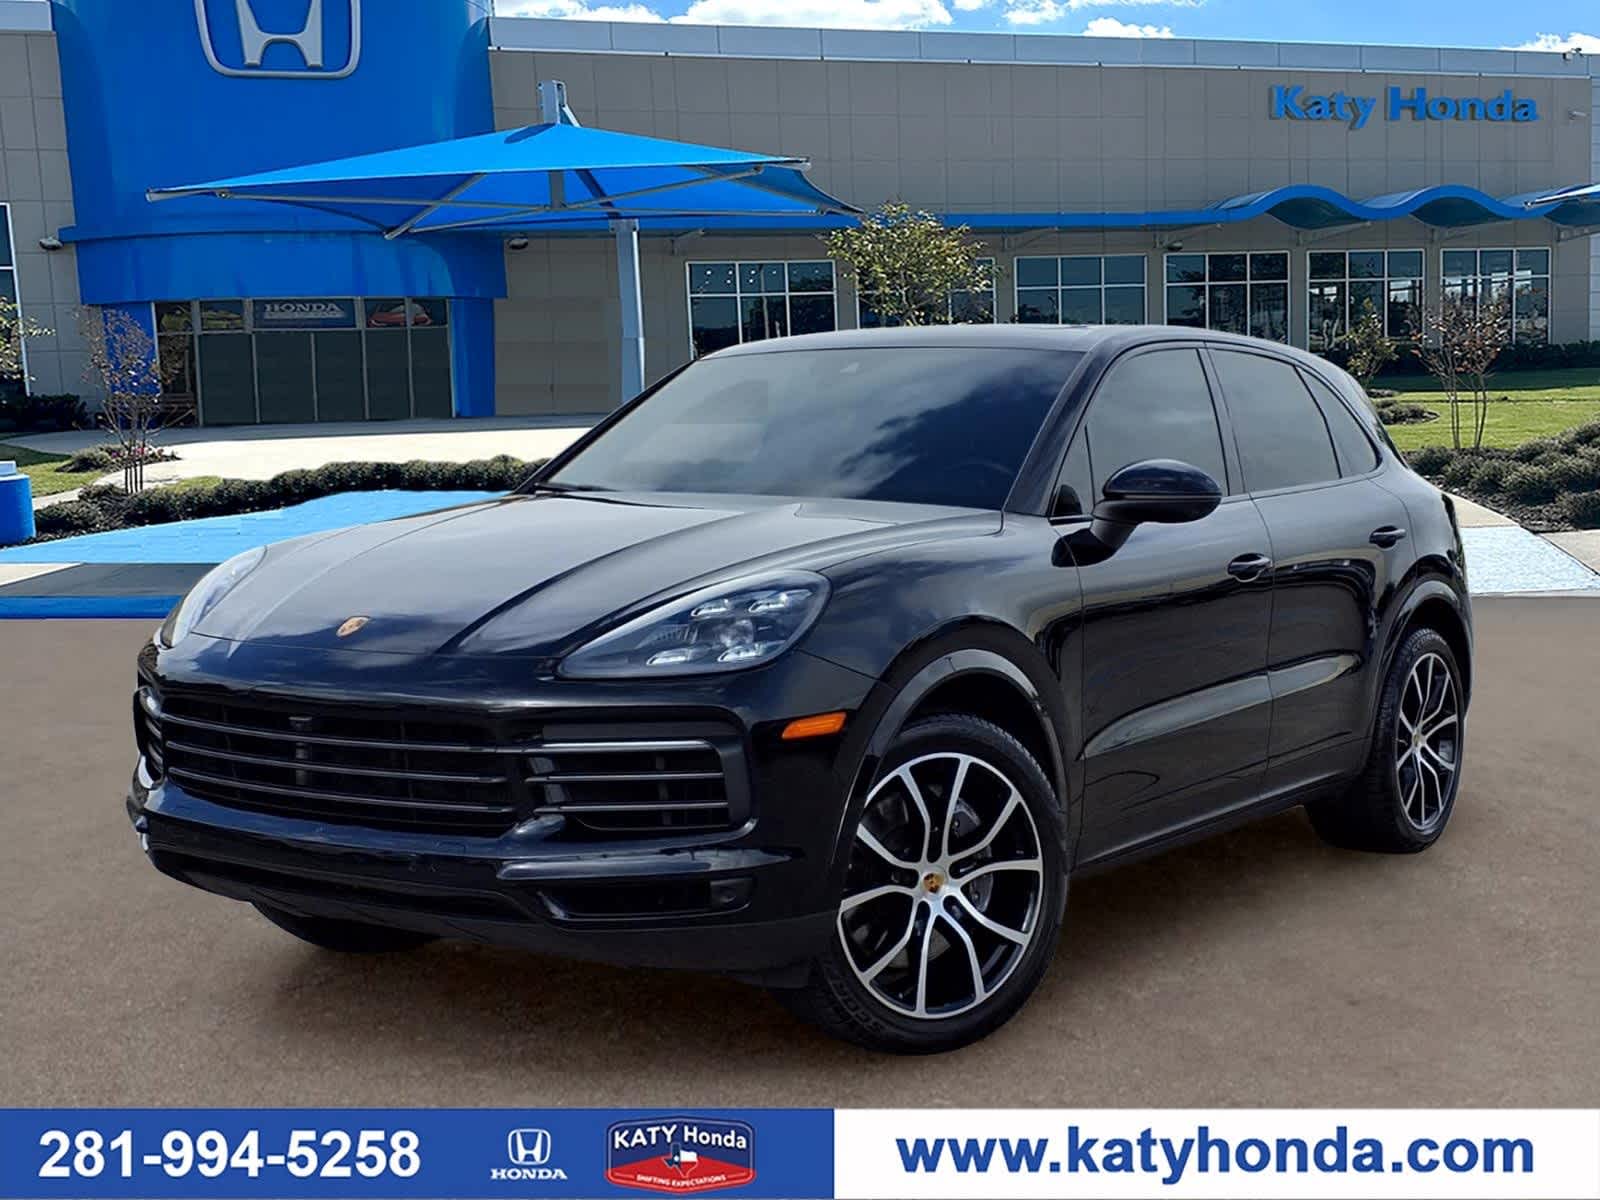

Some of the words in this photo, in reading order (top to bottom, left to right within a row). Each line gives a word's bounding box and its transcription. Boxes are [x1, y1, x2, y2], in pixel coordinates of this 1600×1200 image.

[1271, 84, 1377, 129] Katy
[1387, 86, 1540, 122] Honda
[264, 303, 343, 312] HONDA
